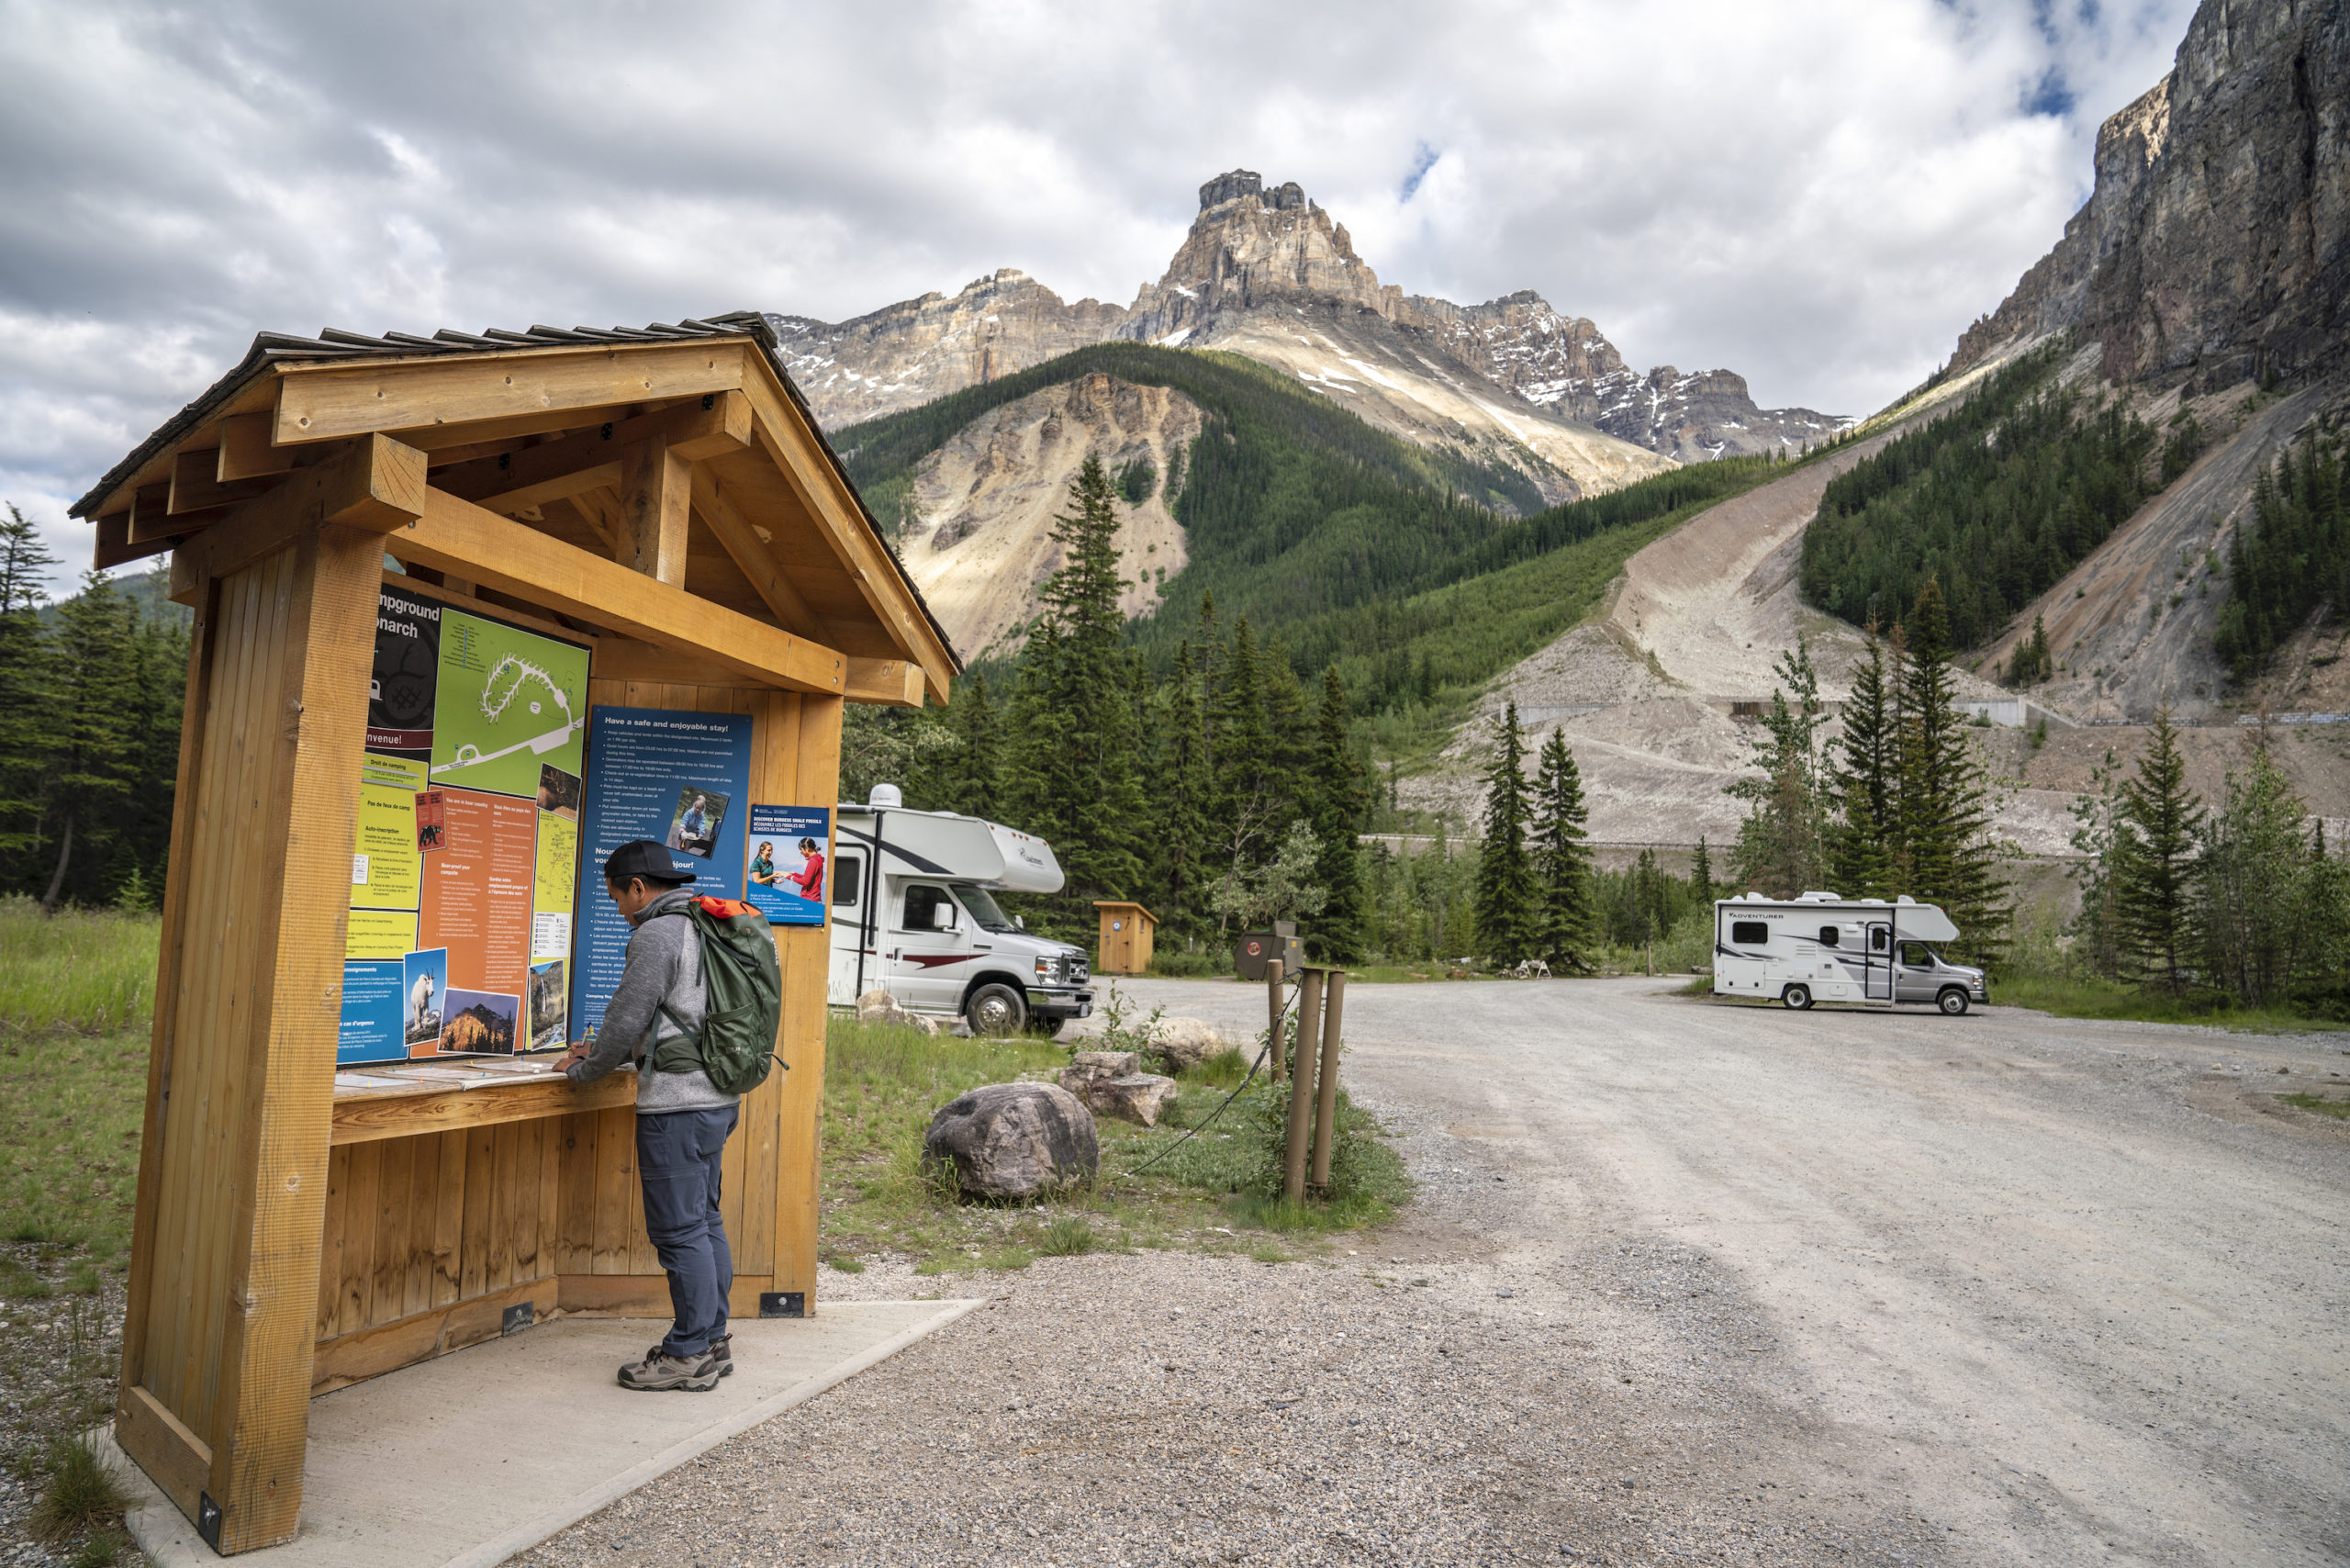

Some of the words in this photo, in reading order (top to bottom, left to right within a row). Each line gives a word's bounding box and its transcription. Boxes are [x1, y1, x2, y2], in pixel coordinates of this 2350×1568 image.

[379, 594, 440, 621] mpground
[377, 618, 418, 638] narch
[670, 721, 707, 731] enjoyable
[709, 723, 728, 732] stay!
[367, 734, 402, 744] nvenue!
